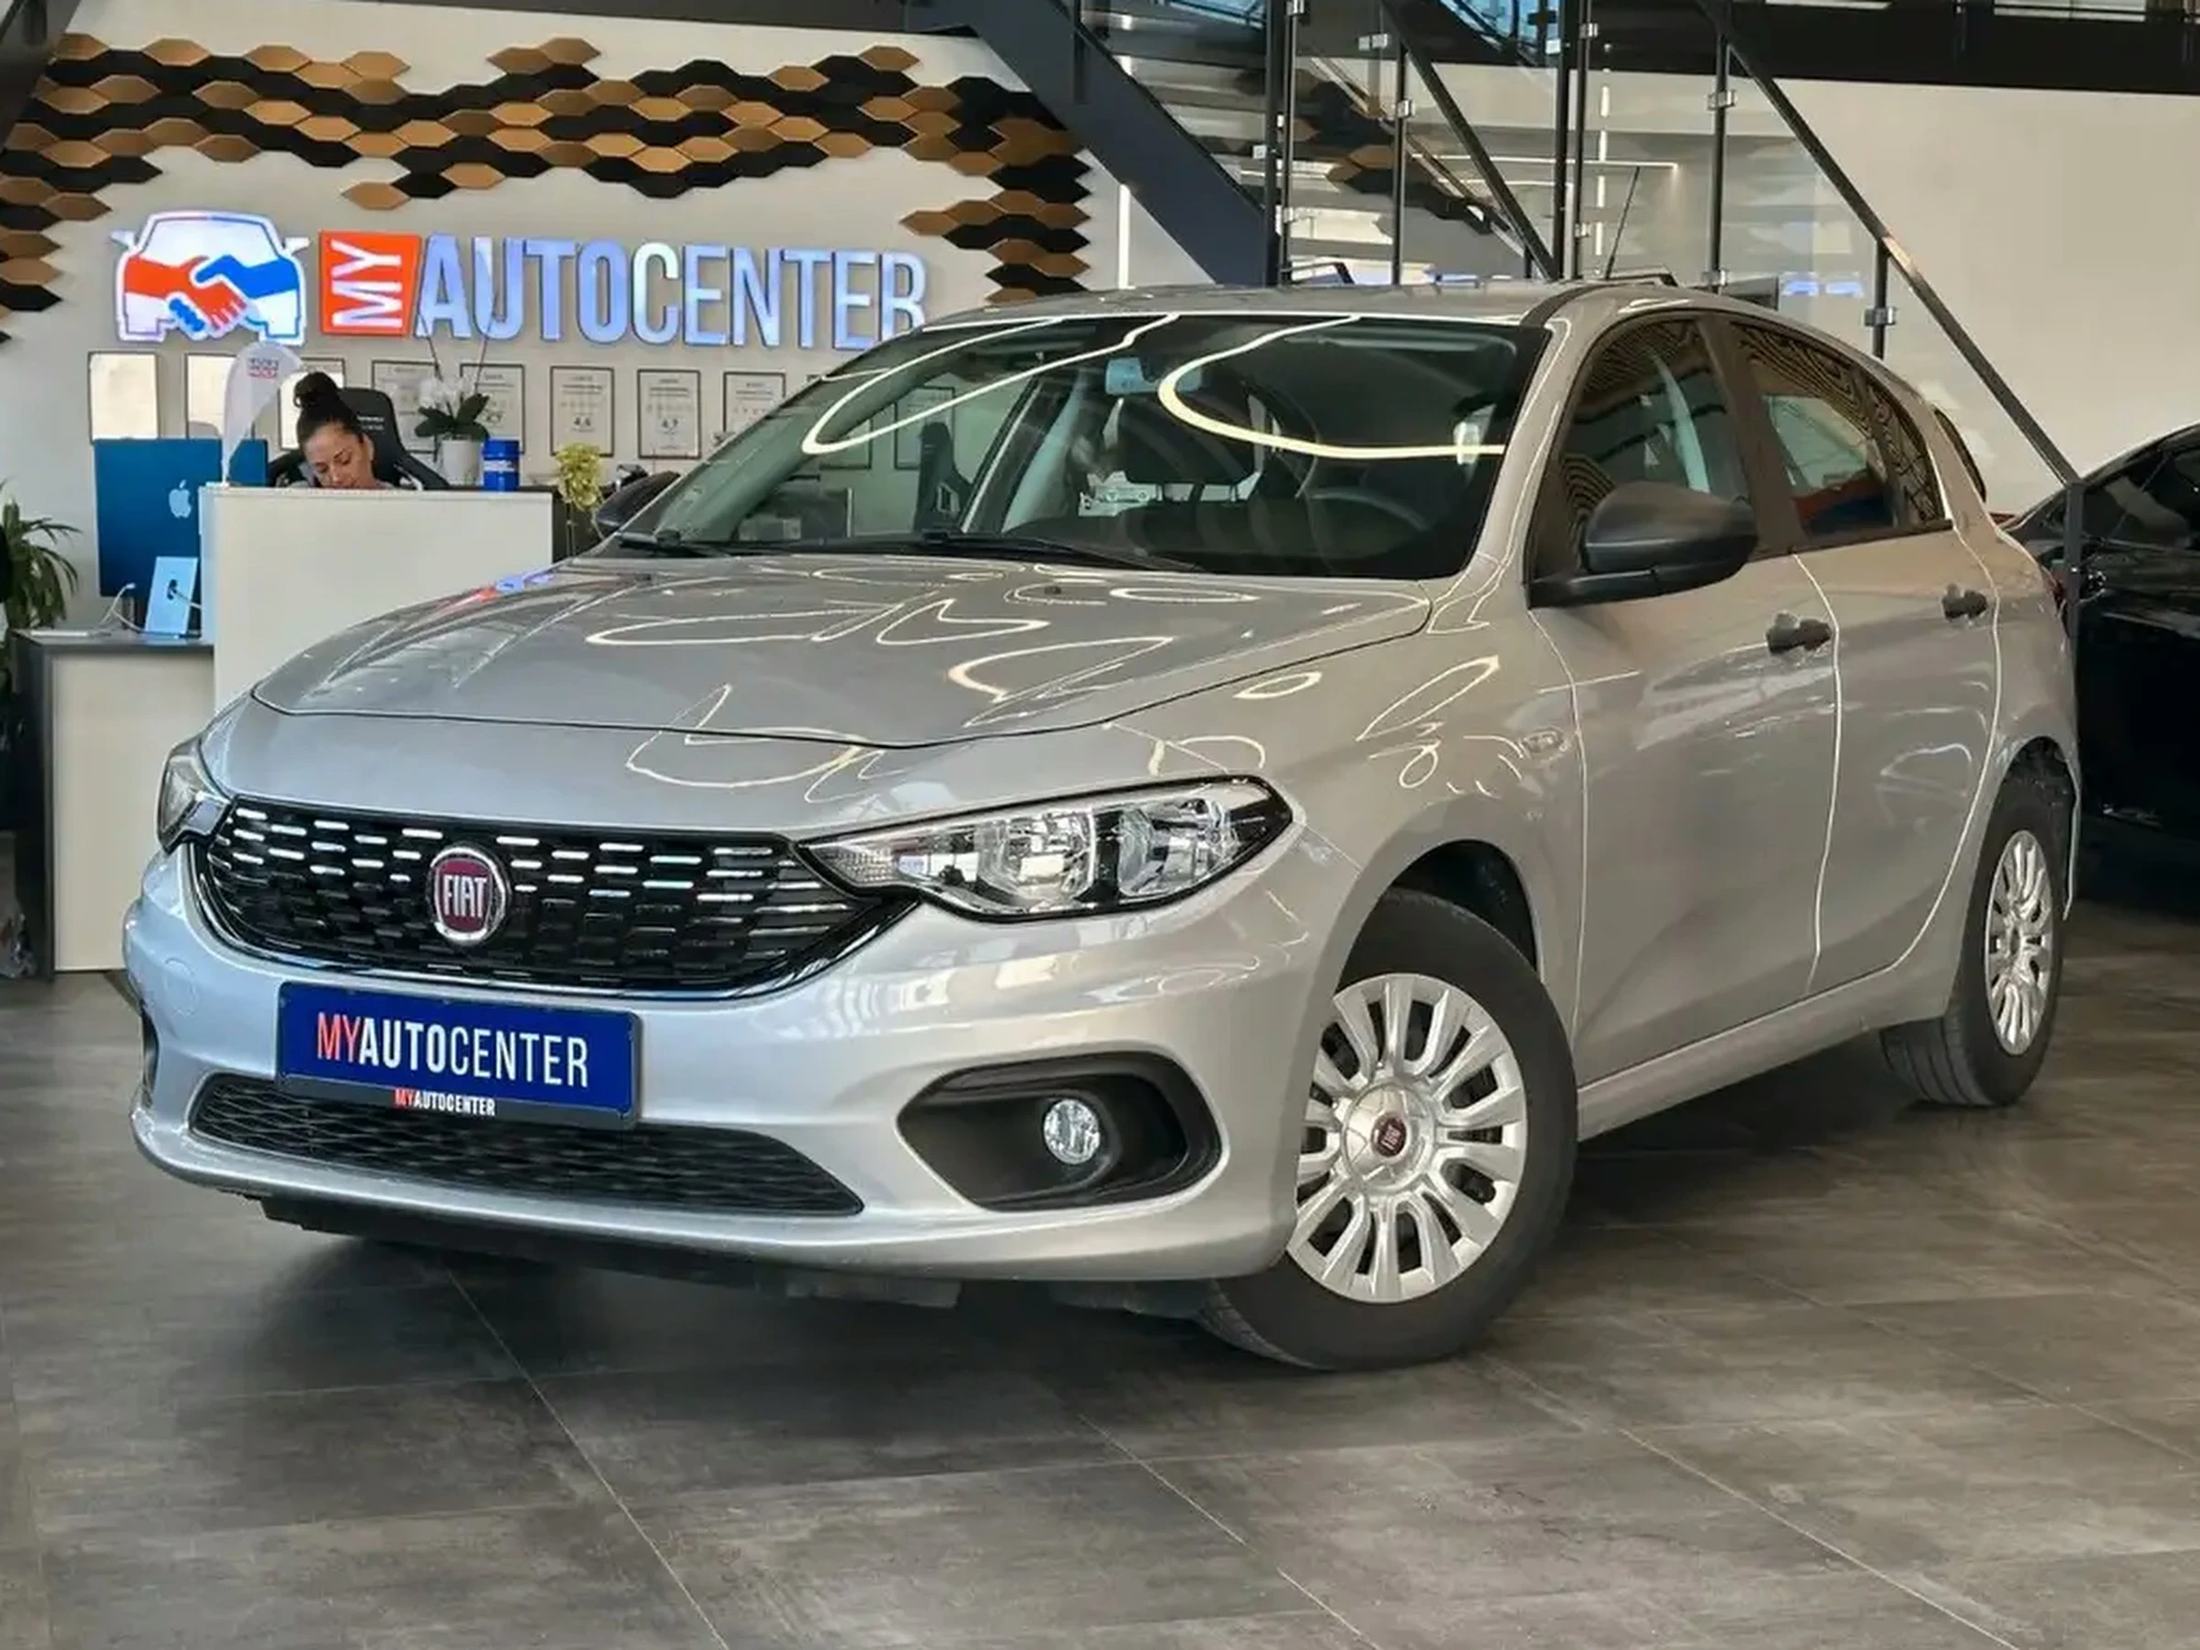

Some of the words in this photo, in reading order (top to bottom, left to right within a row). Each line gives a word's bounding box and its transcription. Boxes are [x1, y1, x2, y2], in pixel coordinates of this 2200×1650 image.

[331, 239, 402, 328] MY
[414, 231, 926, 351] AUTOCENTER
[442, 874, 488, 919] FIAT
